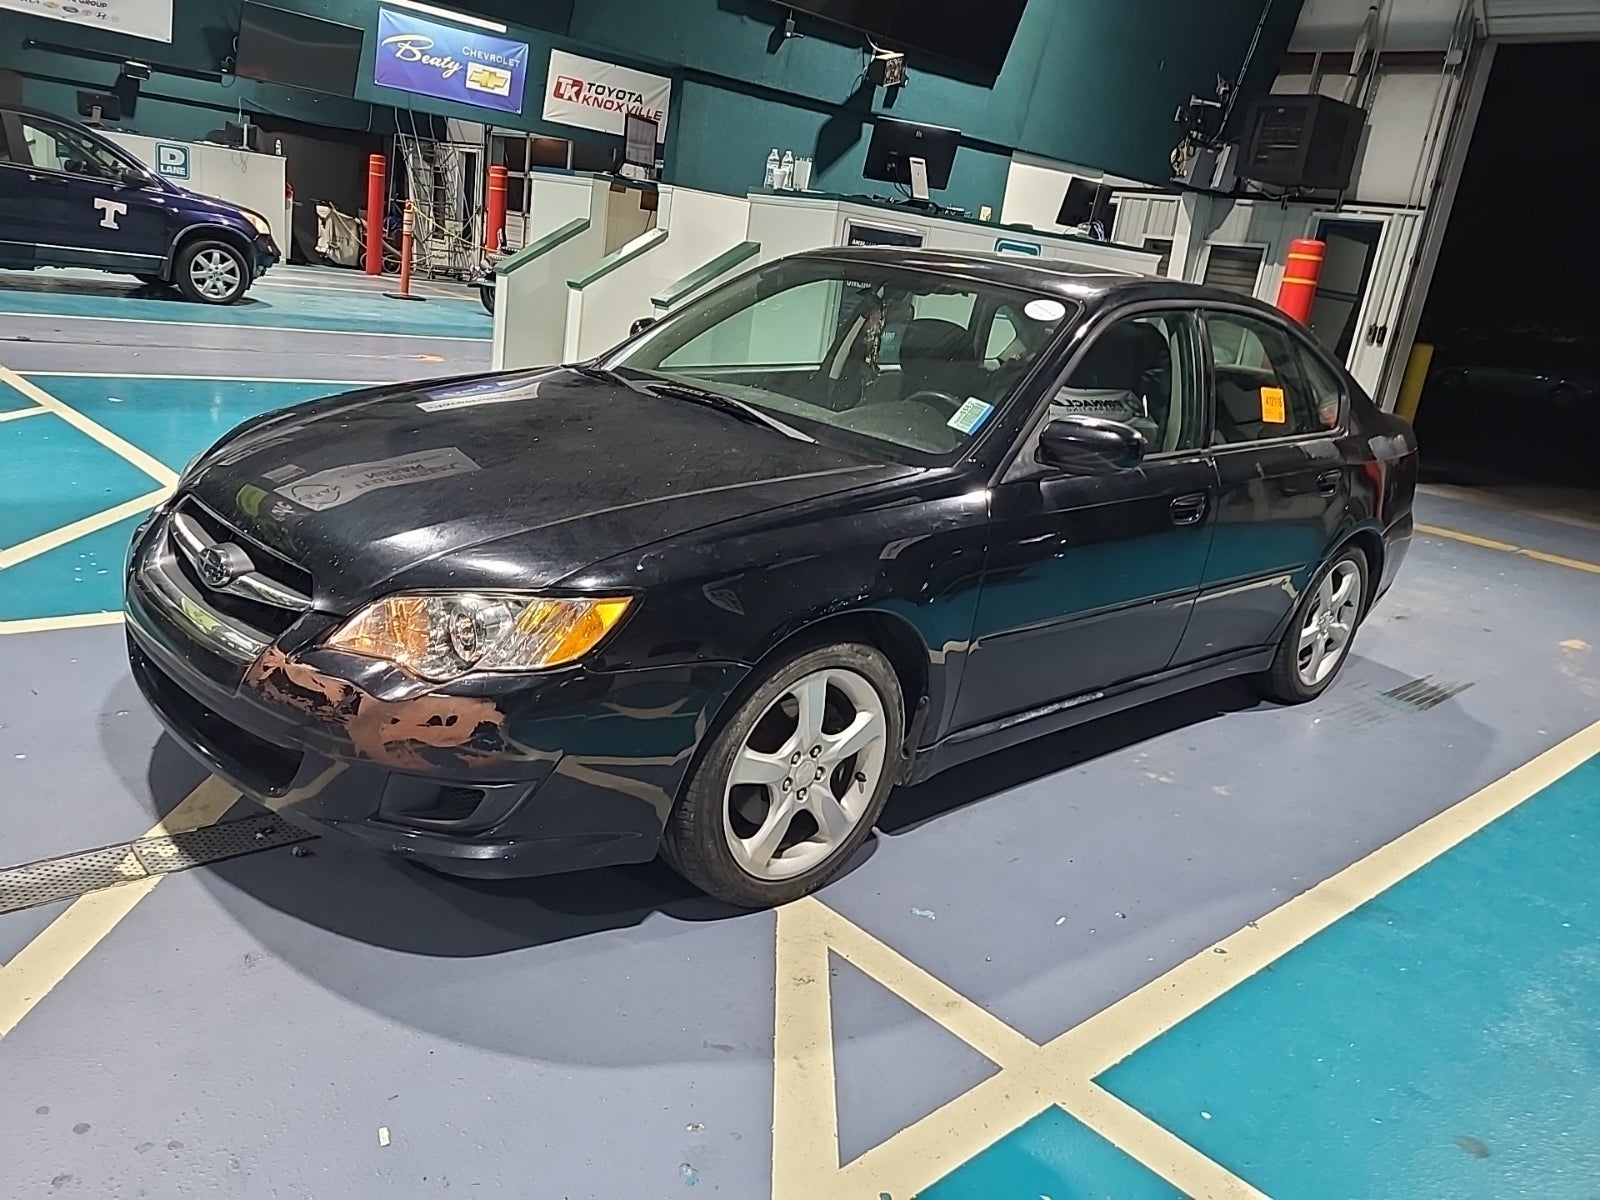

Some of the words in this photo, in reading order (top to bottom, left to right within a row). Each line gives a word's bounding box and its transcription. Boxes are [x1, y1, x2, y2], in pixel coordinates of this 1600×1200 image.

[382, 34, 463, 78] Beaty
[462, 46, 520, 68] CHEVROLET
[587, 82, 643, 104] TOYOTA
[581, 94, 663, 120] KNOXVILLE
[160, 147, 185, 166] D
[160, 165, 186, 175] LANE
[94, 197, 127, 230] T
